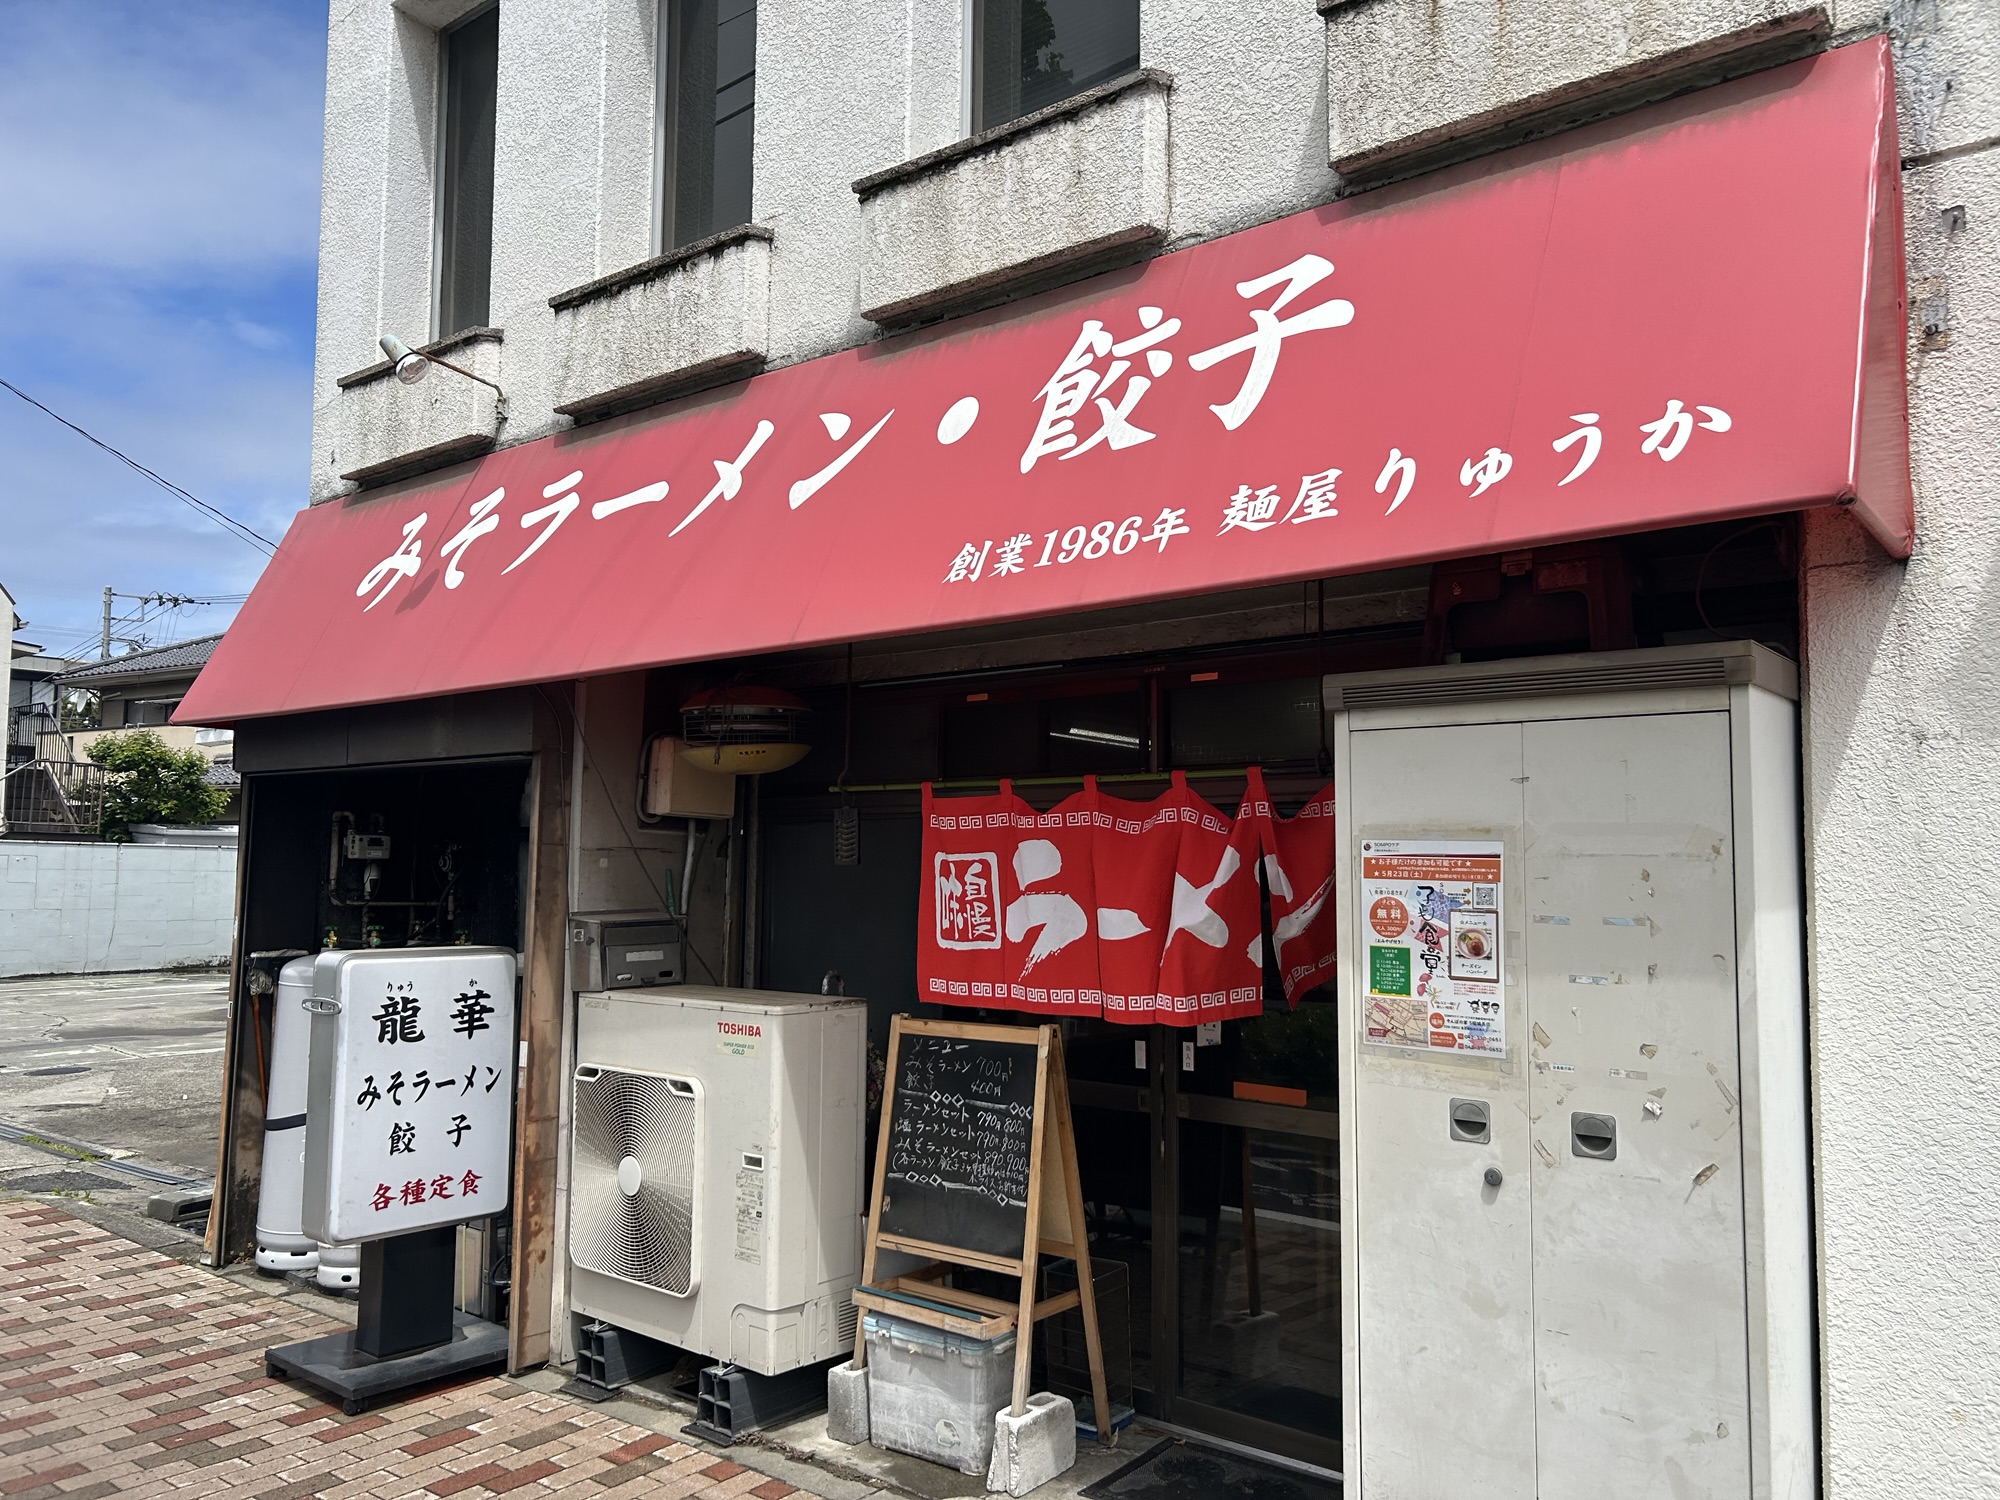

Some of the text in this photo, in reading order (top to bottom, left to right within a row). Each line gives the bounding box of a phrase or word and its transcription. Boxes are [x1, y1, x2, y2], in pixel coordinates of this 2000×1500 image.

[941, 508, 1189, 584] 創業1986年
[1378, 858, 1463, 868] お子様だけの参加も可能です
[1376, 908, 1401, 919] 無料
[387, 981, 413, 993] りゅう
[717, 1022, 762, 1037] TOSHIBA
[357, 1065, 502, 1111] みそラーメン
[369, 1169, 483, 1212] 各種定食
